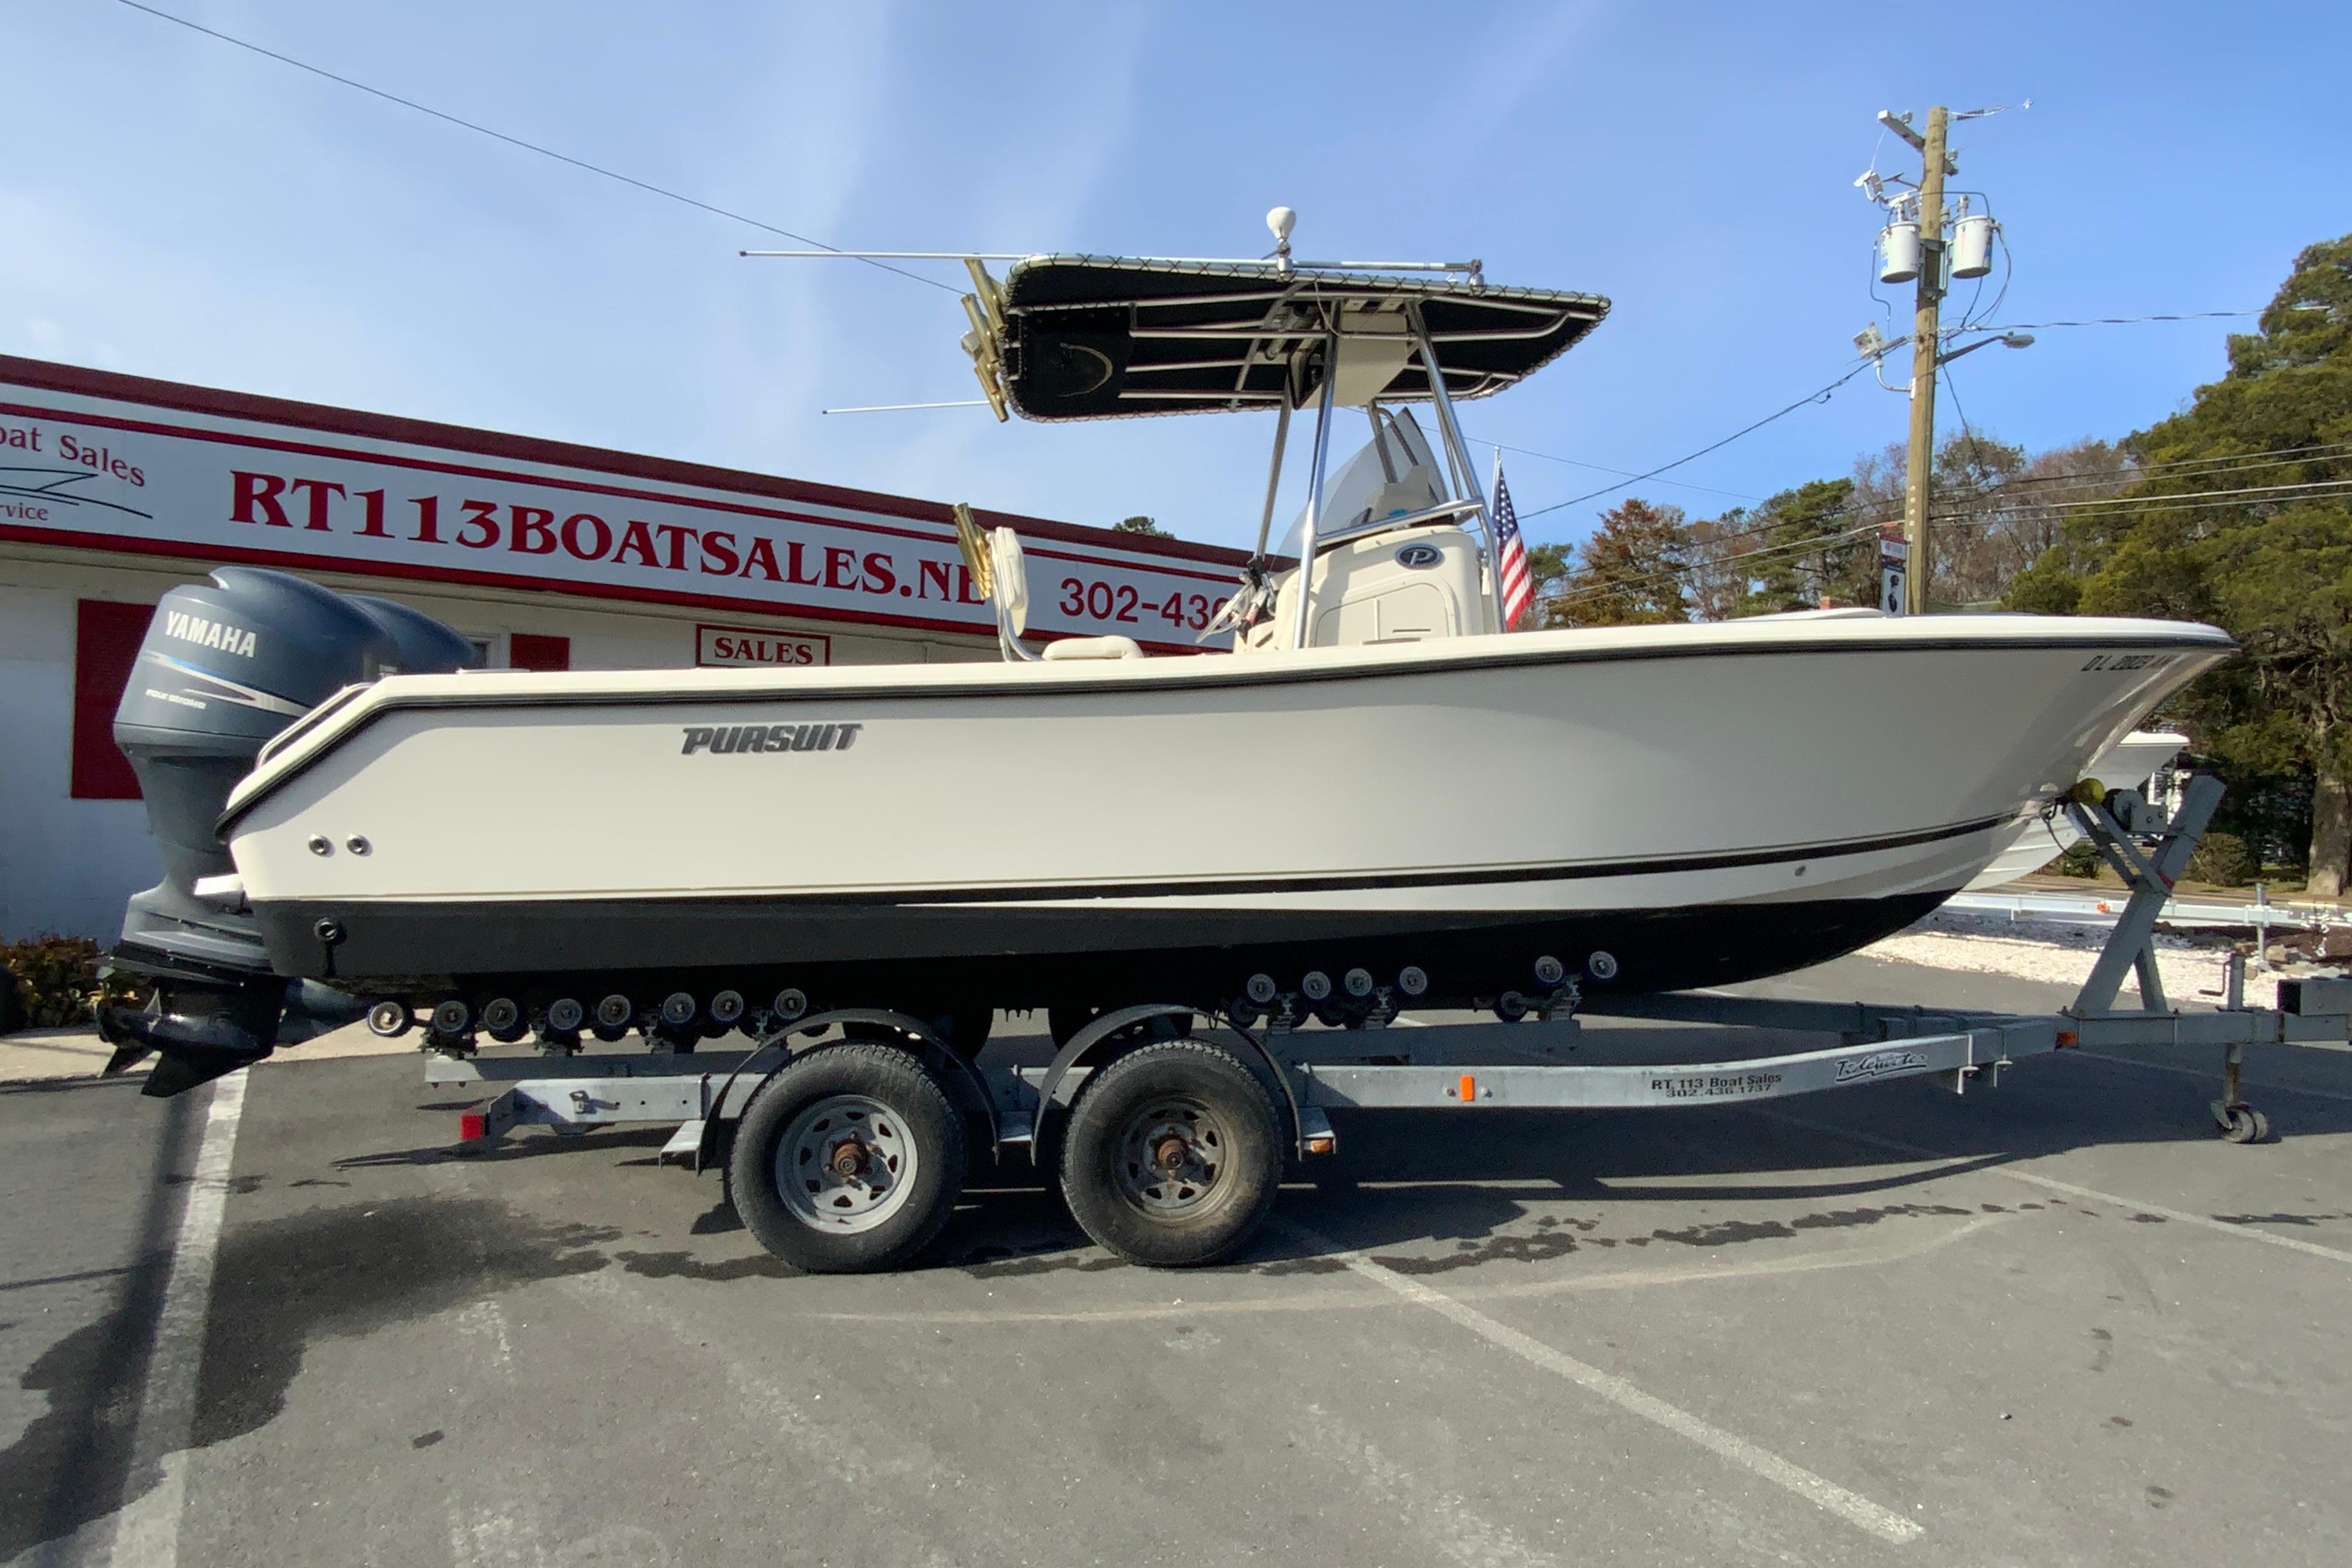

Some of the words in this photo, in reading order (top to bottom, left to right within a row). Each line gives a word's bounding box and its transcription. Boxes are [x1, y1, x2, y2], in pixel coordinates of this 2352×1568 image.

[60, 435, 145, 488] Sales
[228, 469, 986, 606] RT113BOATSALES.NE
[165, 610, 257, 659] YAMAHA
[713, 636, 814, 666] SALES
[681, 723, 863, 755] PURSUIT
[1679, 1078, 1704, 1089] 113
[1710, 1077, 1742, 1088] Boat
[1747, 1073, 1782, 1086] Sales
